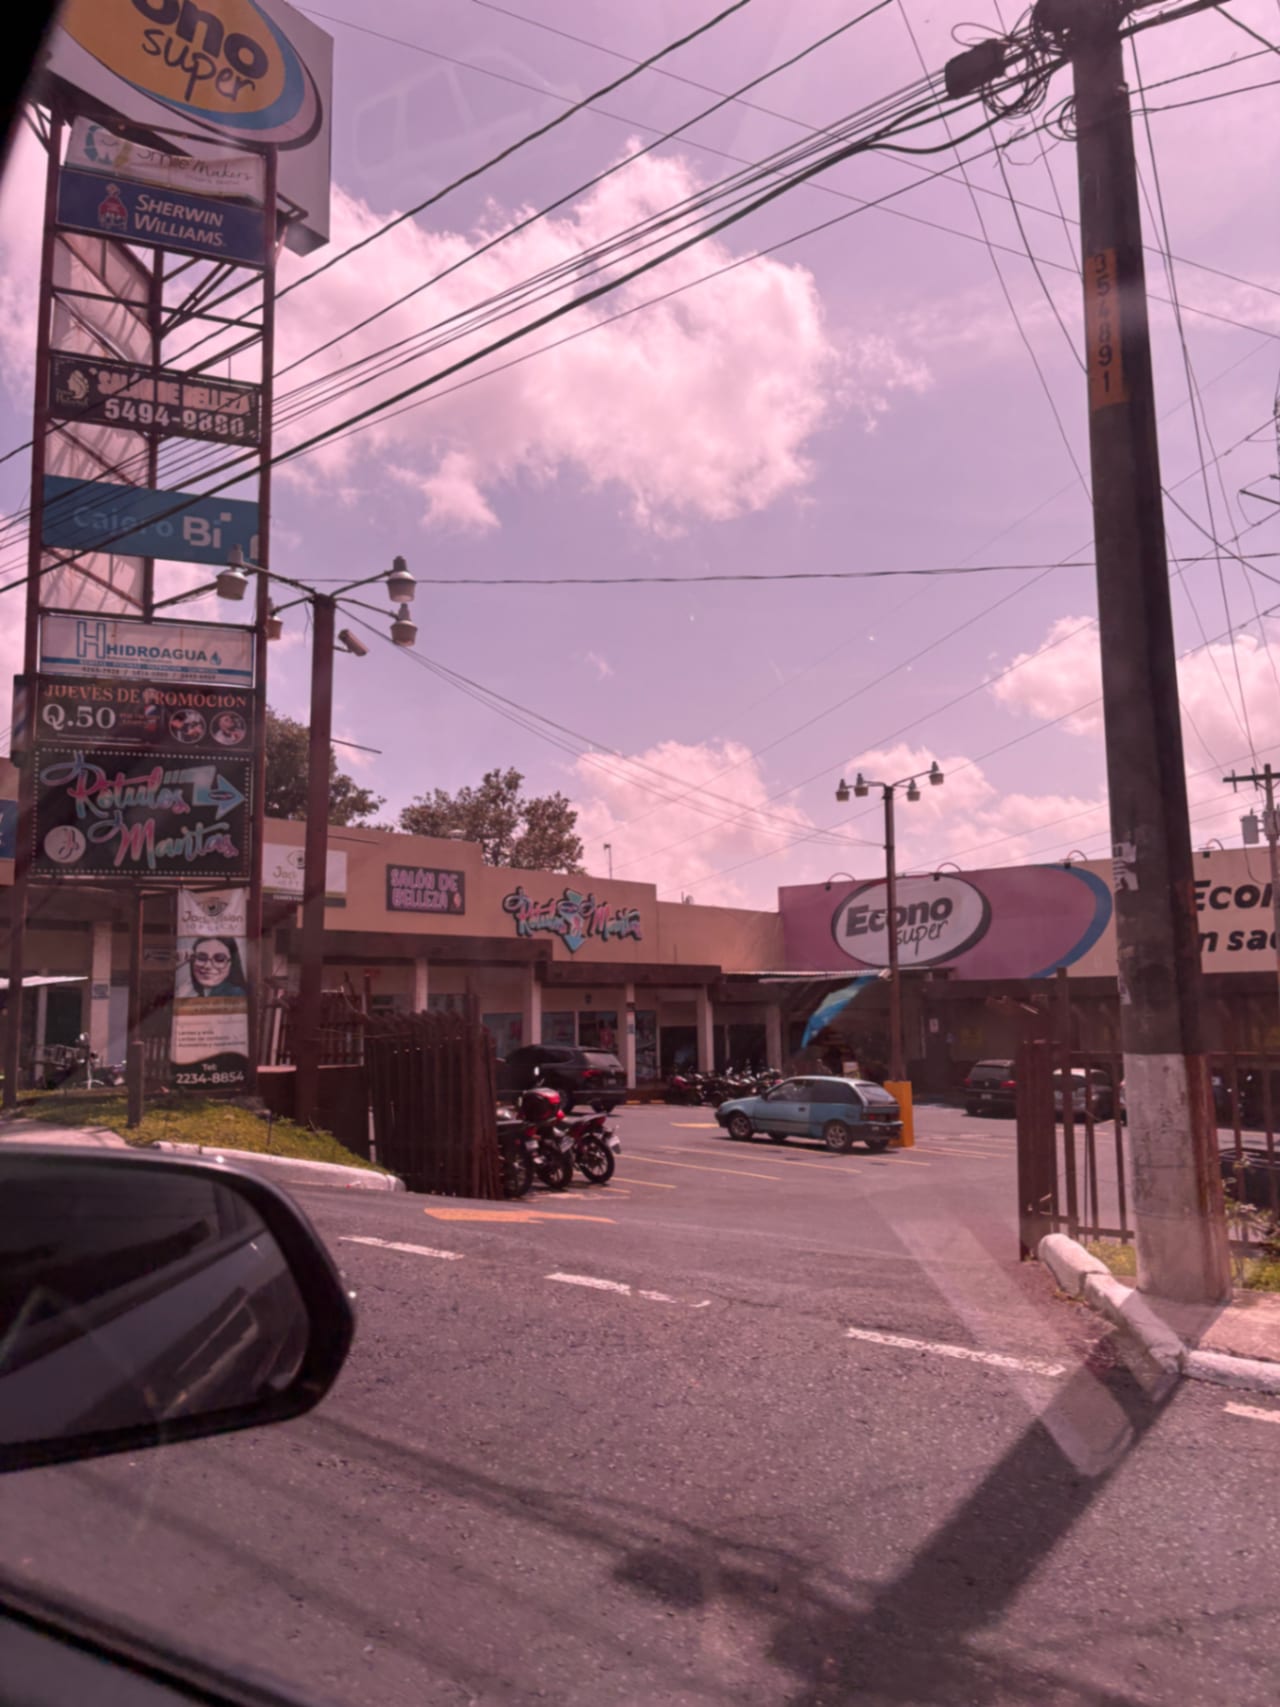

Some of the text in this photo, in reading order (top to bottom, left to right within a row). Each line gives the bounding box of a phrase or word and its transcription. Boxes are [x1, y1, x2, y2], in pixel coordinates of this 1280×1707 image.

[140, 28, 257, 102] super
[135, 193, 224, 227] SHERWIN
[133, 212, 225, 246] WILLIAMS
[182, 512, 232, 549] Bi
[106, 643, 208, 663] HIDROAGUA
[45, 685, 113, 702] JUEVES
[117, 687, 140, 704] DE
[42, 703, 116, 731] Q.50
[390, 868, 459, 892] SALÓN DE
[391, 888, 448, 911] BELLEZA
[895, 916, 948, 955] super
[176, 1070, 245, 1085] 2234-8854
